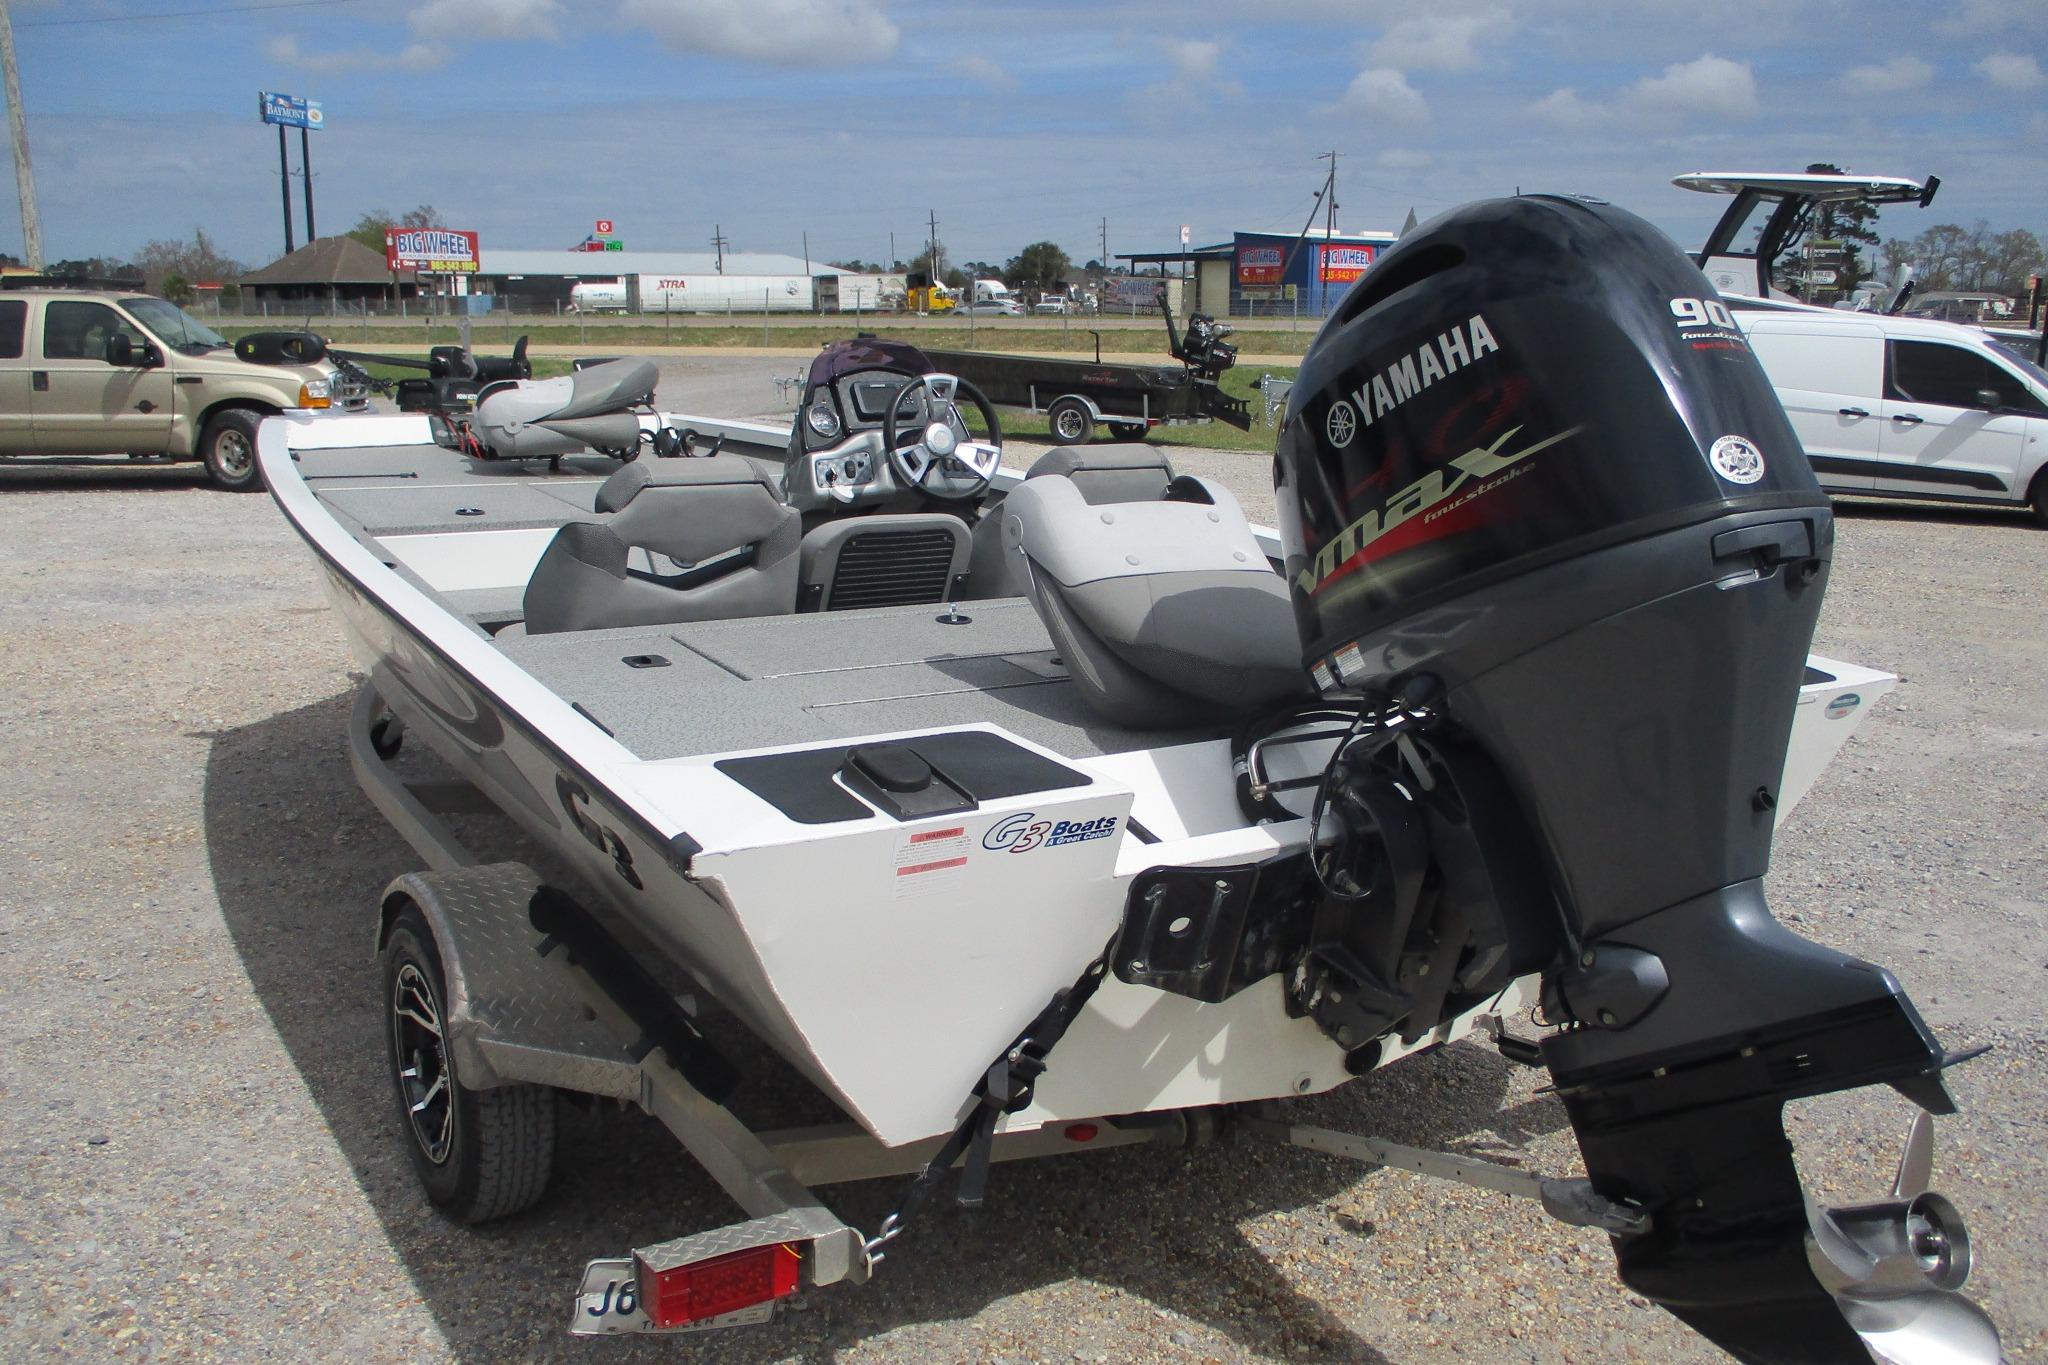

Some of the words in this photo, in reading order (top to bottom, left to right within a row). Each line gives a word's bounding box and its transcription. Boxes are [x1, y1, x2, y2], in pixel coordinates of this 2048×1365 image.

[266, 103, 306, 120] BAYMONT
[398, 232, 423, 254] BIG
[424, 231, 472, 256] WHEEL
[1339, 249, 1370, 265] WHEEL
[656, 279, 686, 291] XTRA
[1669, 297, 1735, 328] 90
[1351, 314, 1499, 427] YAMAHA
[982, 812, 1053, 853] G3
[1051, 816, 1118, 837] Boats
[1056, 835, 1081, 845] Great
[1083, 828, 1113, 841] Catch!
